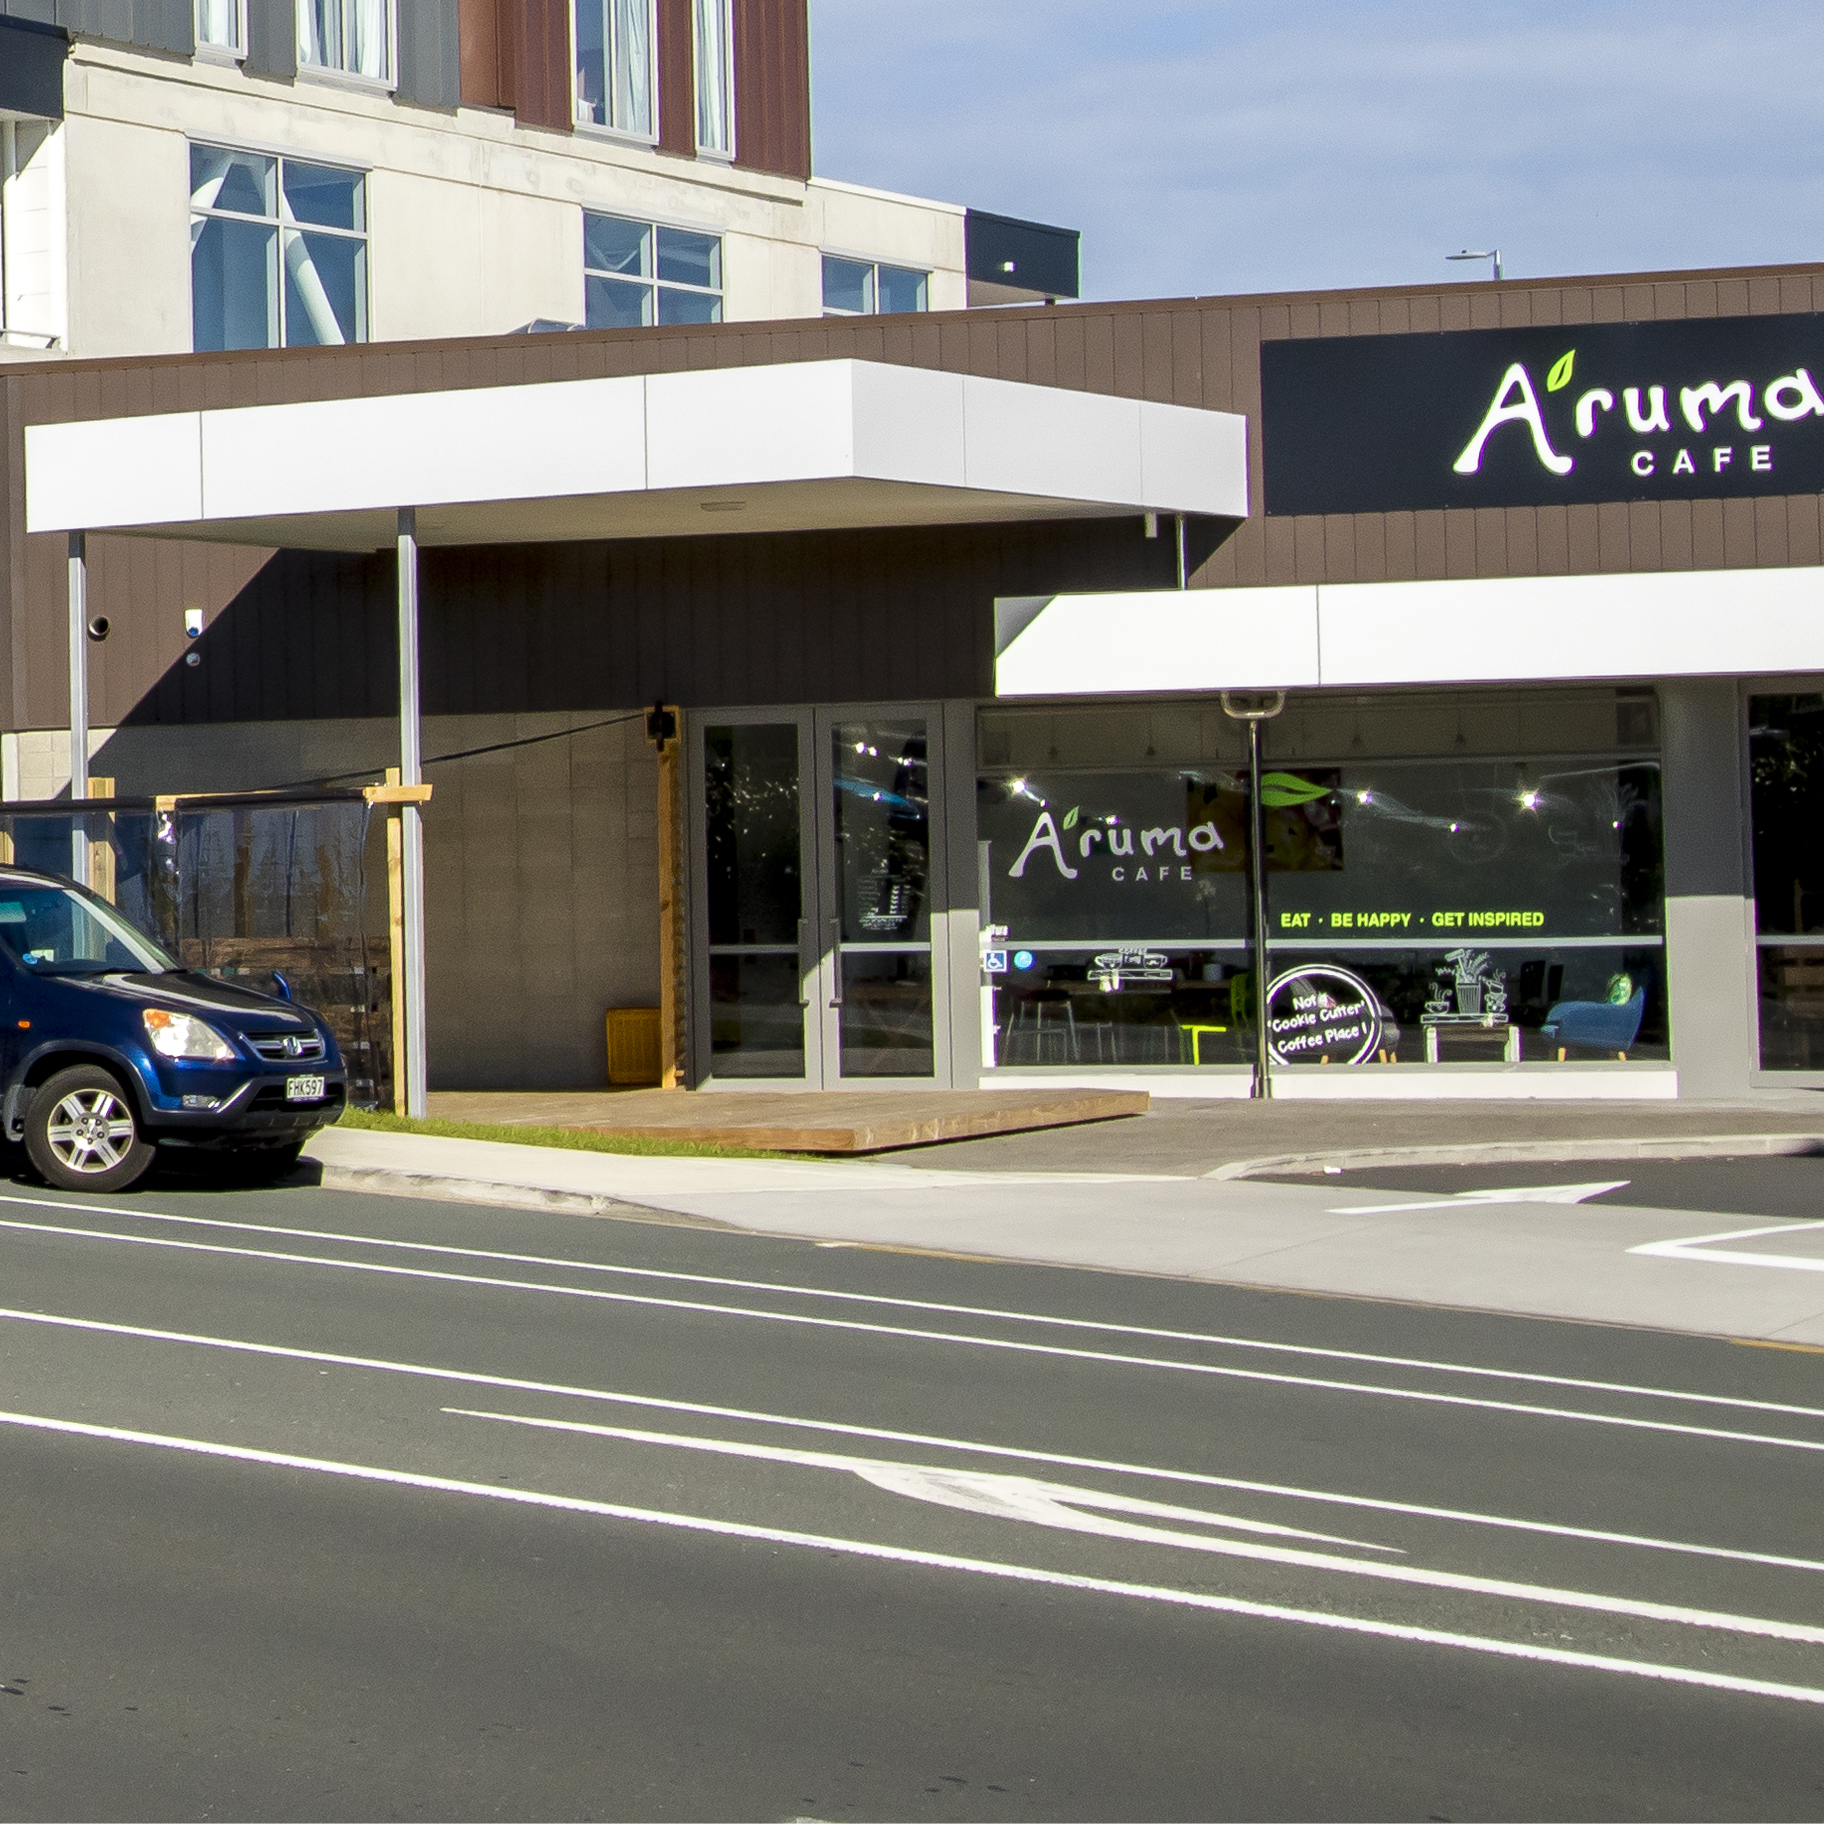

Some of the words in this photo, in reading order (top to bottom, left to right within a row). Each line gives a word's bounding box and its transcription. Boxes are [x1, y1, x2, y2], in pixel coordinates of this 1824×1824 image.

[1631, 444, 1772, 476] CAFE
[1112, 866, 1193, 882] CAFE
[1281, 913, 1311, 928] EAT
[1331, 913, 1353, 927] BE
[1357, 913, 1412, 927] HAPPY
[1432, 912, 1465, 927] GET
[1469, 912, 1545, 926] INSPIRED
[1293, 994, 1317, 1010] Not
[1277, 1035, 1324, 1053] Coffee
[1324, 1025, 1360, 1043] Place
[288, 1079, 323, 1095] FHK597
